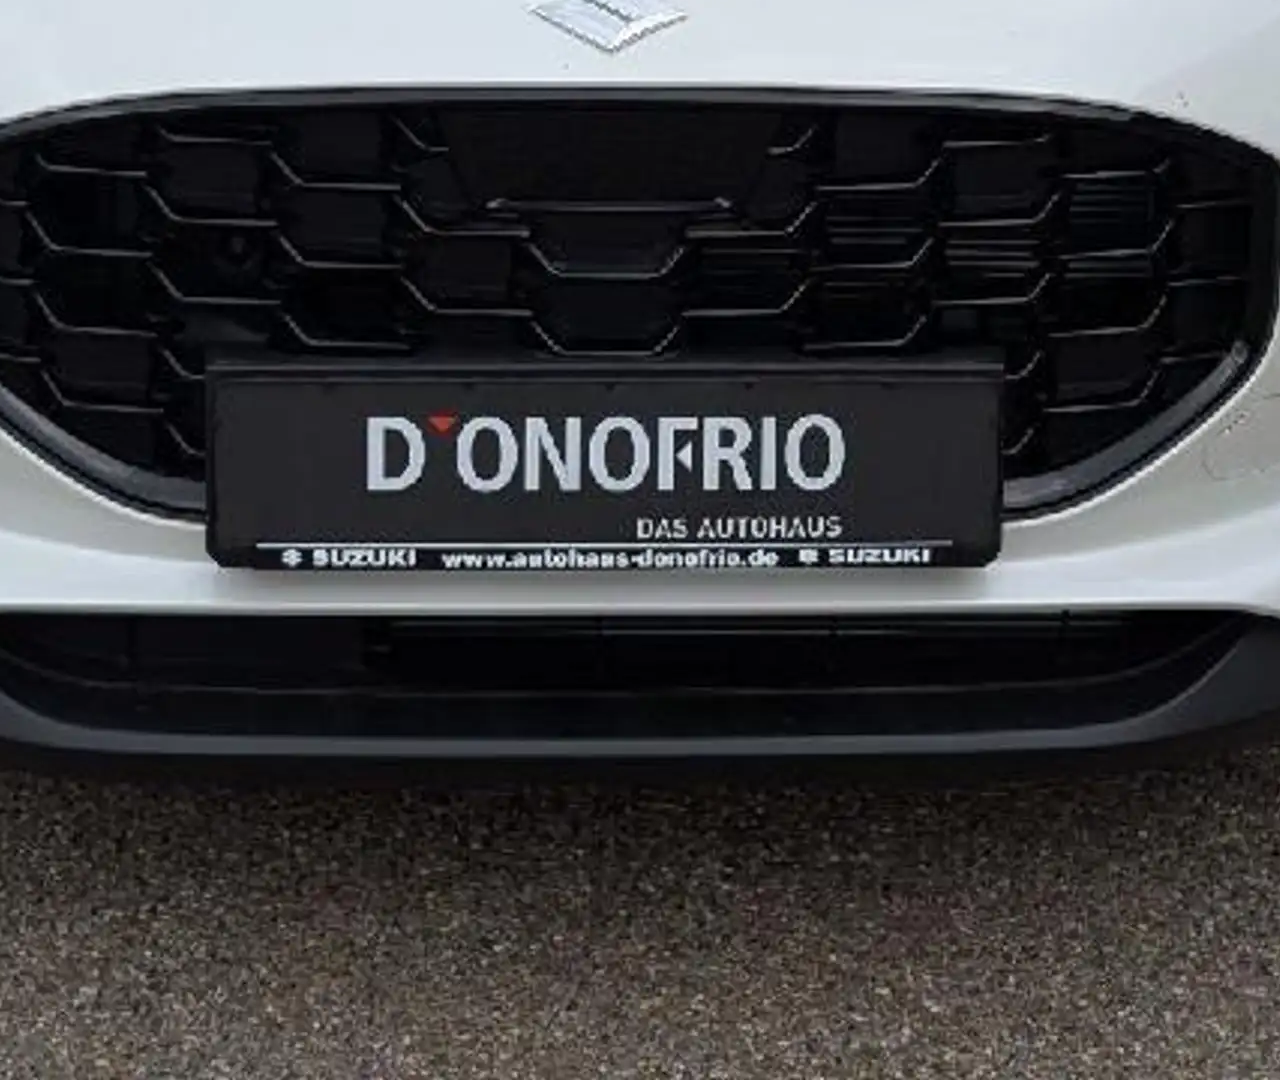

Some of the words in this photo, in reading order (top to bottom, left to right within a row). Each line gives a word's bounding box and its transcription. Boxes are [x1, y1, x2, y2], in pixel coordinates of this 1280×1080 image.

[636, 517, 689, 540] DAS
[696, 516, 844, 539] AUTOHAUS
[311, 548, 418, 568] SUZUKI
[440, 548, 780, 569] www.autohaus-donofrio.de
[827, 547, 932, 564] SUZUKI
